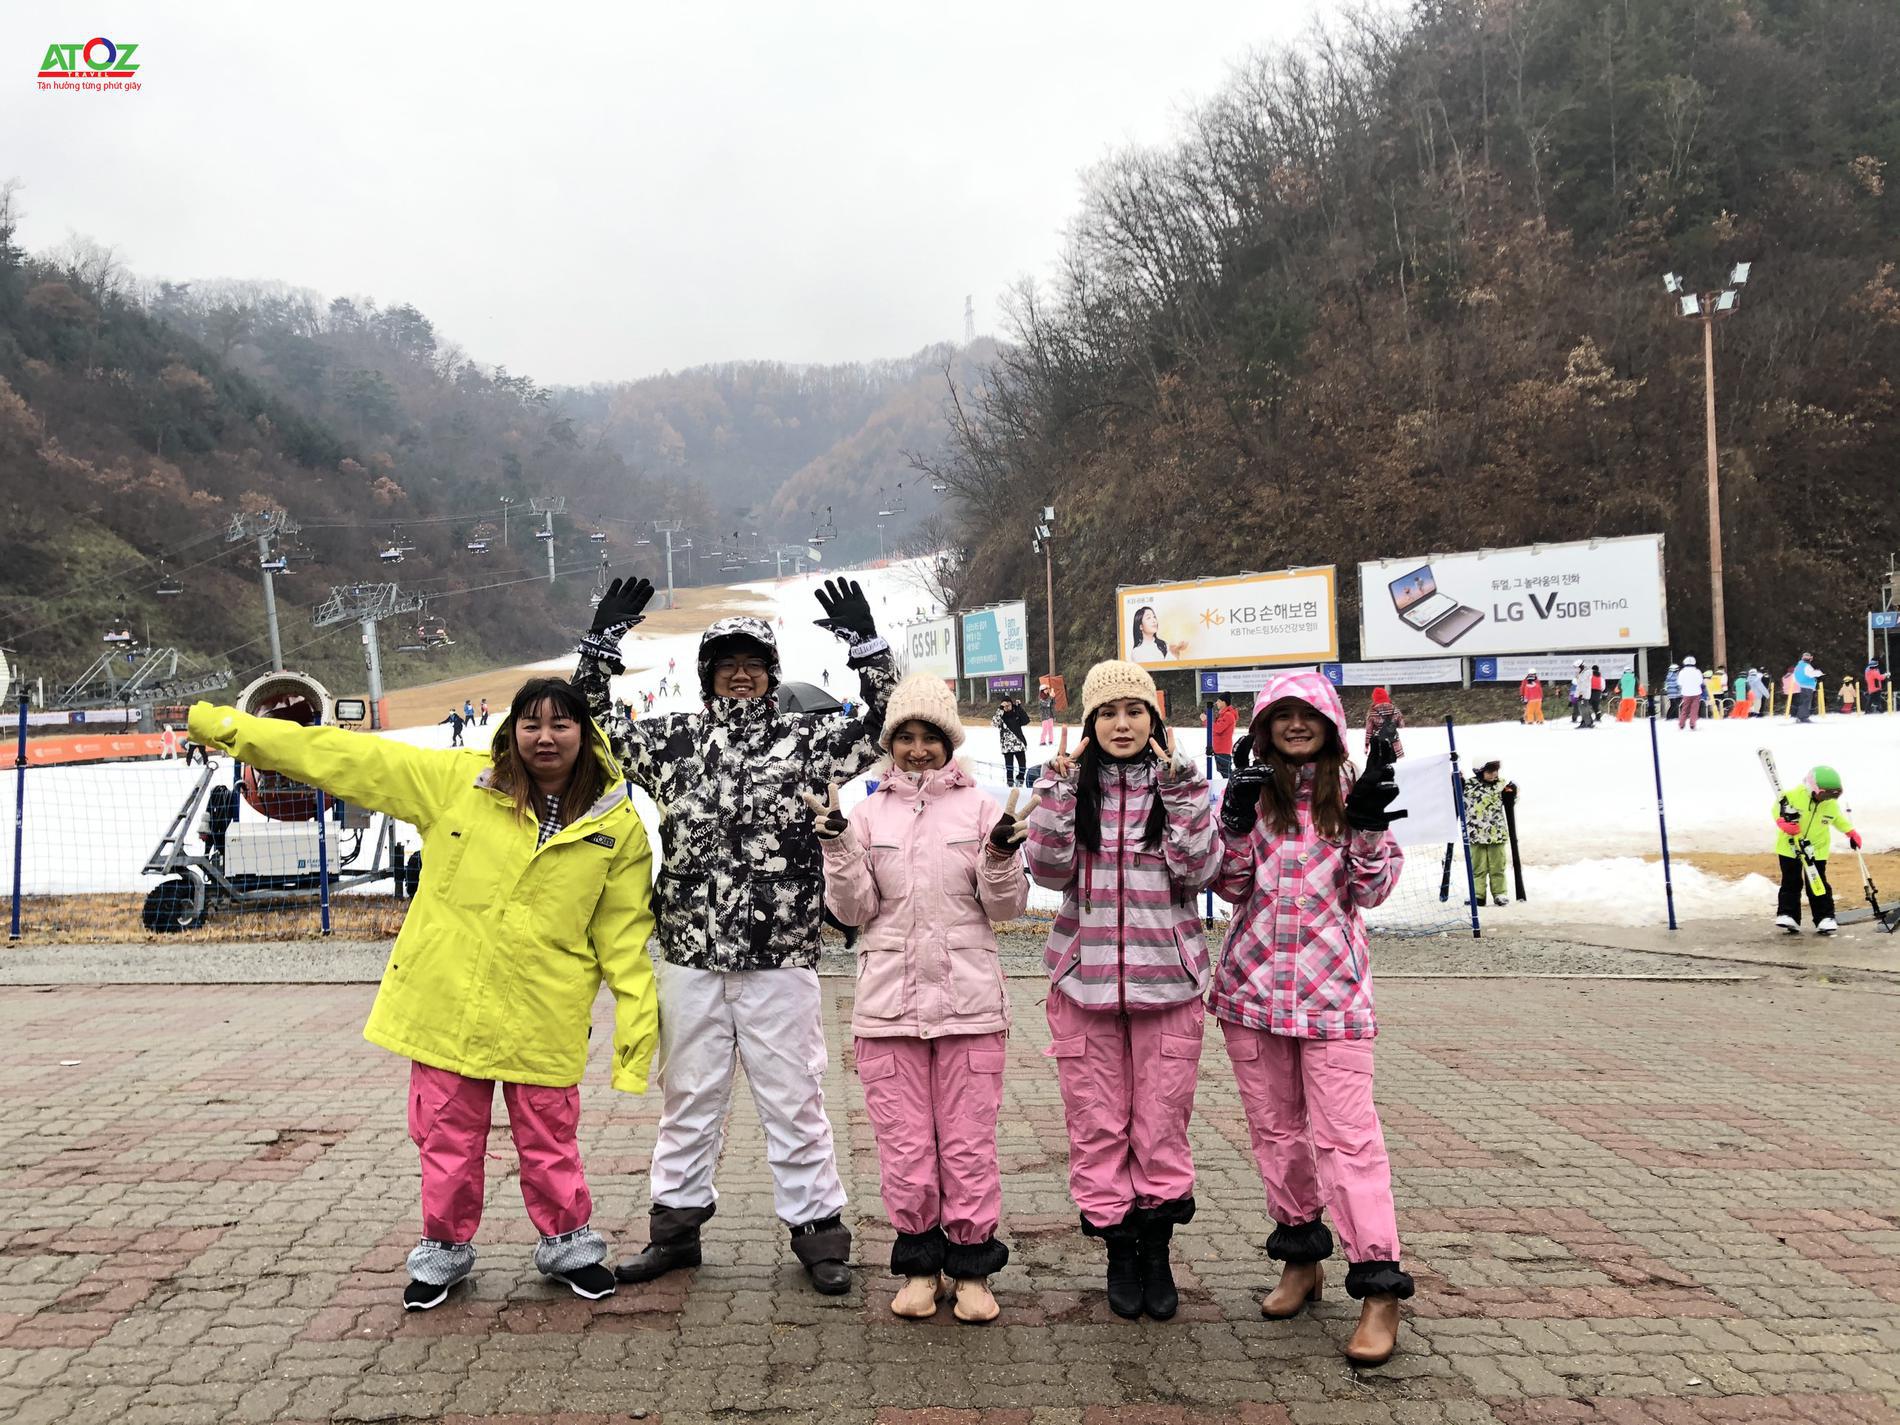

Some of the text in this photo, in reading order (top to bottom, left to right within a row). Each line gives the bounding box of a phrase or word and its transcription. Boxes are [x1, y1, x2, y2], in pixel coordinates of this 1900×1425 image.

[1229, 600, 1318, 624] KB 손해보험
[1493, 602, 1524, 622] LG
[1592, 598, 1628, 611] ThinQ
[1008, 626, 1020, 640] your
[1230, 627, 1241, 637] KB
[912, 632, 924, 658] GS
[1004, 637, 1024, 651] Energy
[687, 823, 713, 843] THREE
[696, 836, 711, 850] SIX
[699, 846, 718, 864] NINE
